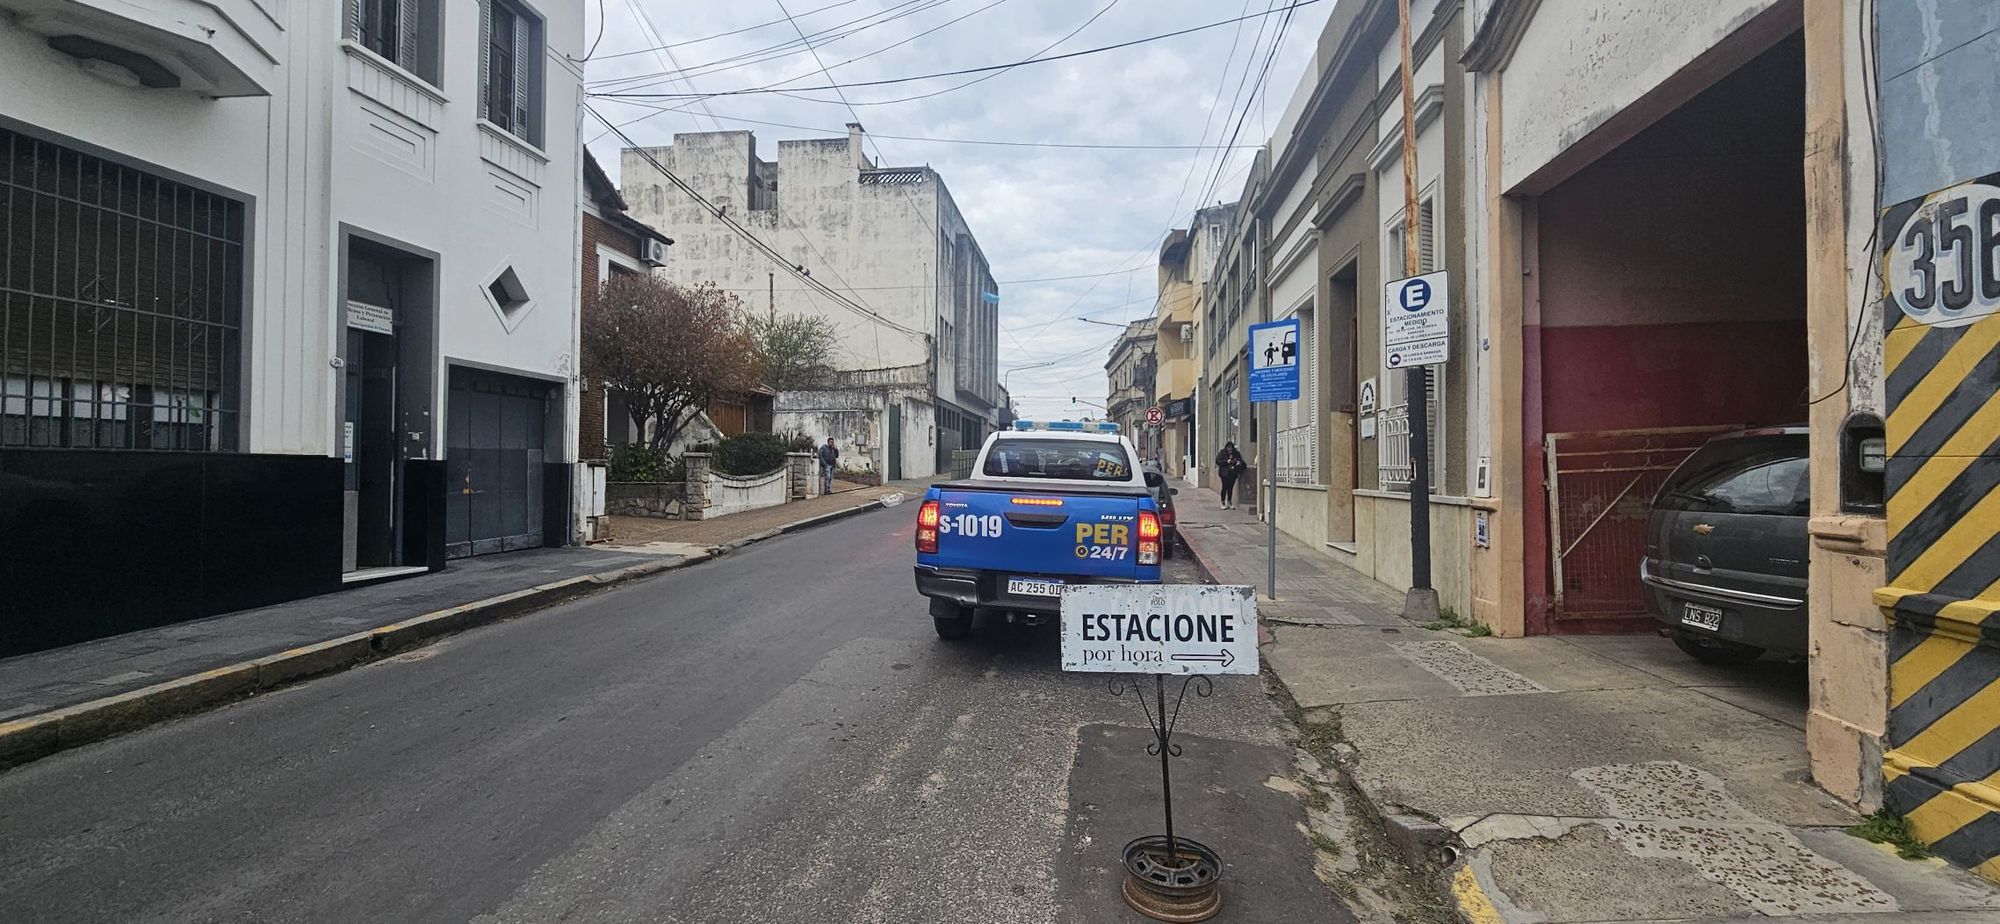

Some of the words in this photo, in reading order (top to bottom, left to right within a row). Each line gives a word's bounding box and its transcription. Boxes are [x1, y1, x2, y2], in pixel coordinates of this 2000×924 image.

[1406, 284, 1425, 308] E
[1389, 309, 1444, 323] ESTACIONAMIENTO
[1404, 318, 1427, 326] MEDIDO
[1388, 345, 1407, 353] CARGA
[1412, 341, 1446, 350] DESCARGA
[1097, 458, 1124, 477] PER
[939, 514, 1002, 538] S-1019
[1076, 523, 1129, 545] PER
[1090, 545, 1128, 560] 24/7
[1011, 581, 1023, 593] AC
[1026, 582, 1046, 594] 255
[1685, 608, 1701, 621] LNS
[1082, 614, 1234, 642] ESTACIONE
[1083, 648, 1115, 665] por
[1121, 644, 1164, 662] hora
